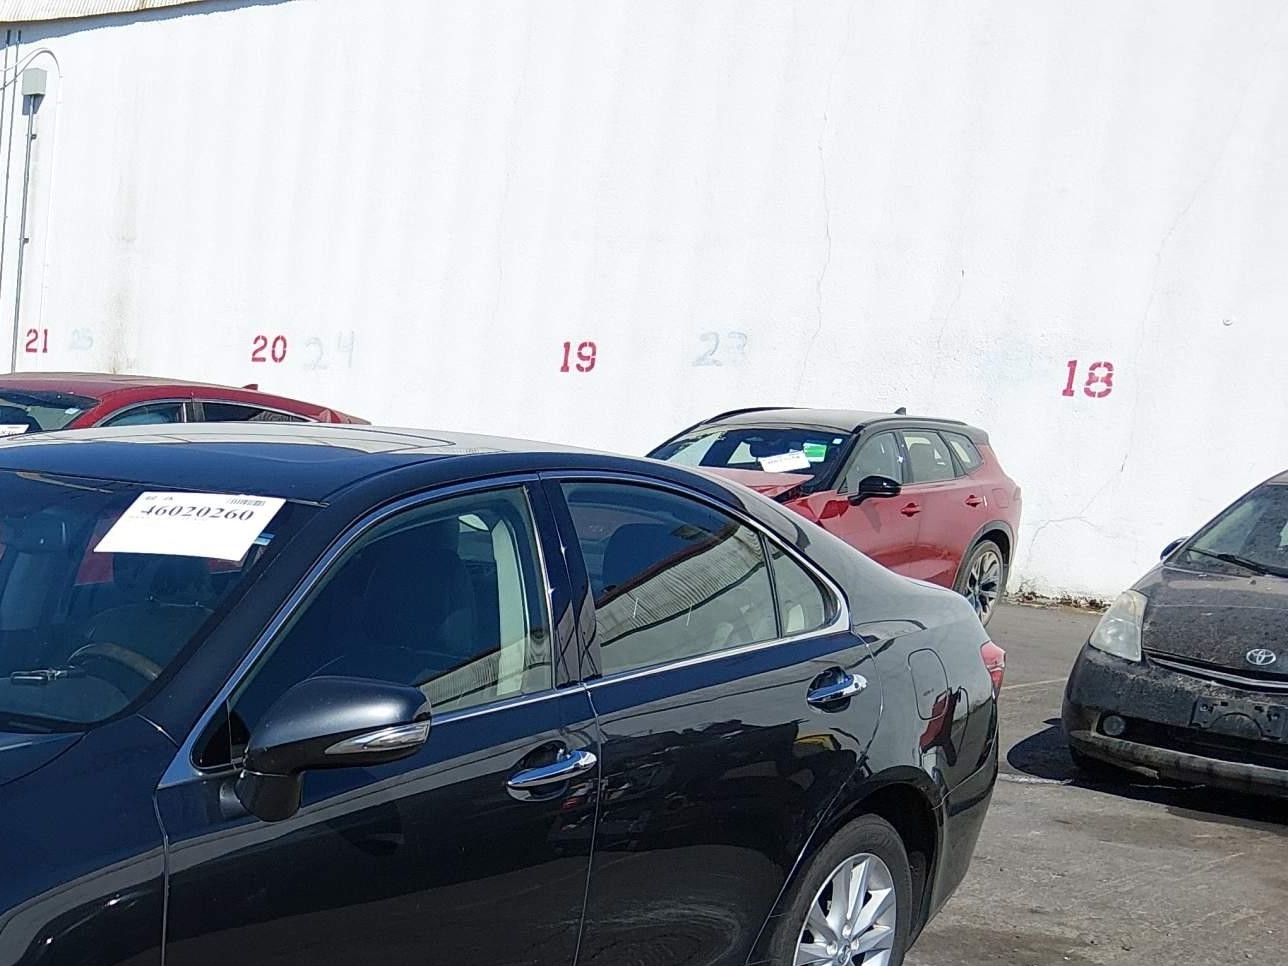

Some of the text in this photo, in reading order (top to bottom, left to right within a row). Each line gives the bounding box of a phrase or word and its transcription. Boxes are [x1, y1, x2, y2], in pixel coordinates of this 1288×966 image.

[25, 328, 48, 353] 21
[251, 335, 287, 363] 20
[560, 341, 597, 373] 19
[1062, 360, 1114, 398] 18
[141, 505, 254, 521] 46020260
